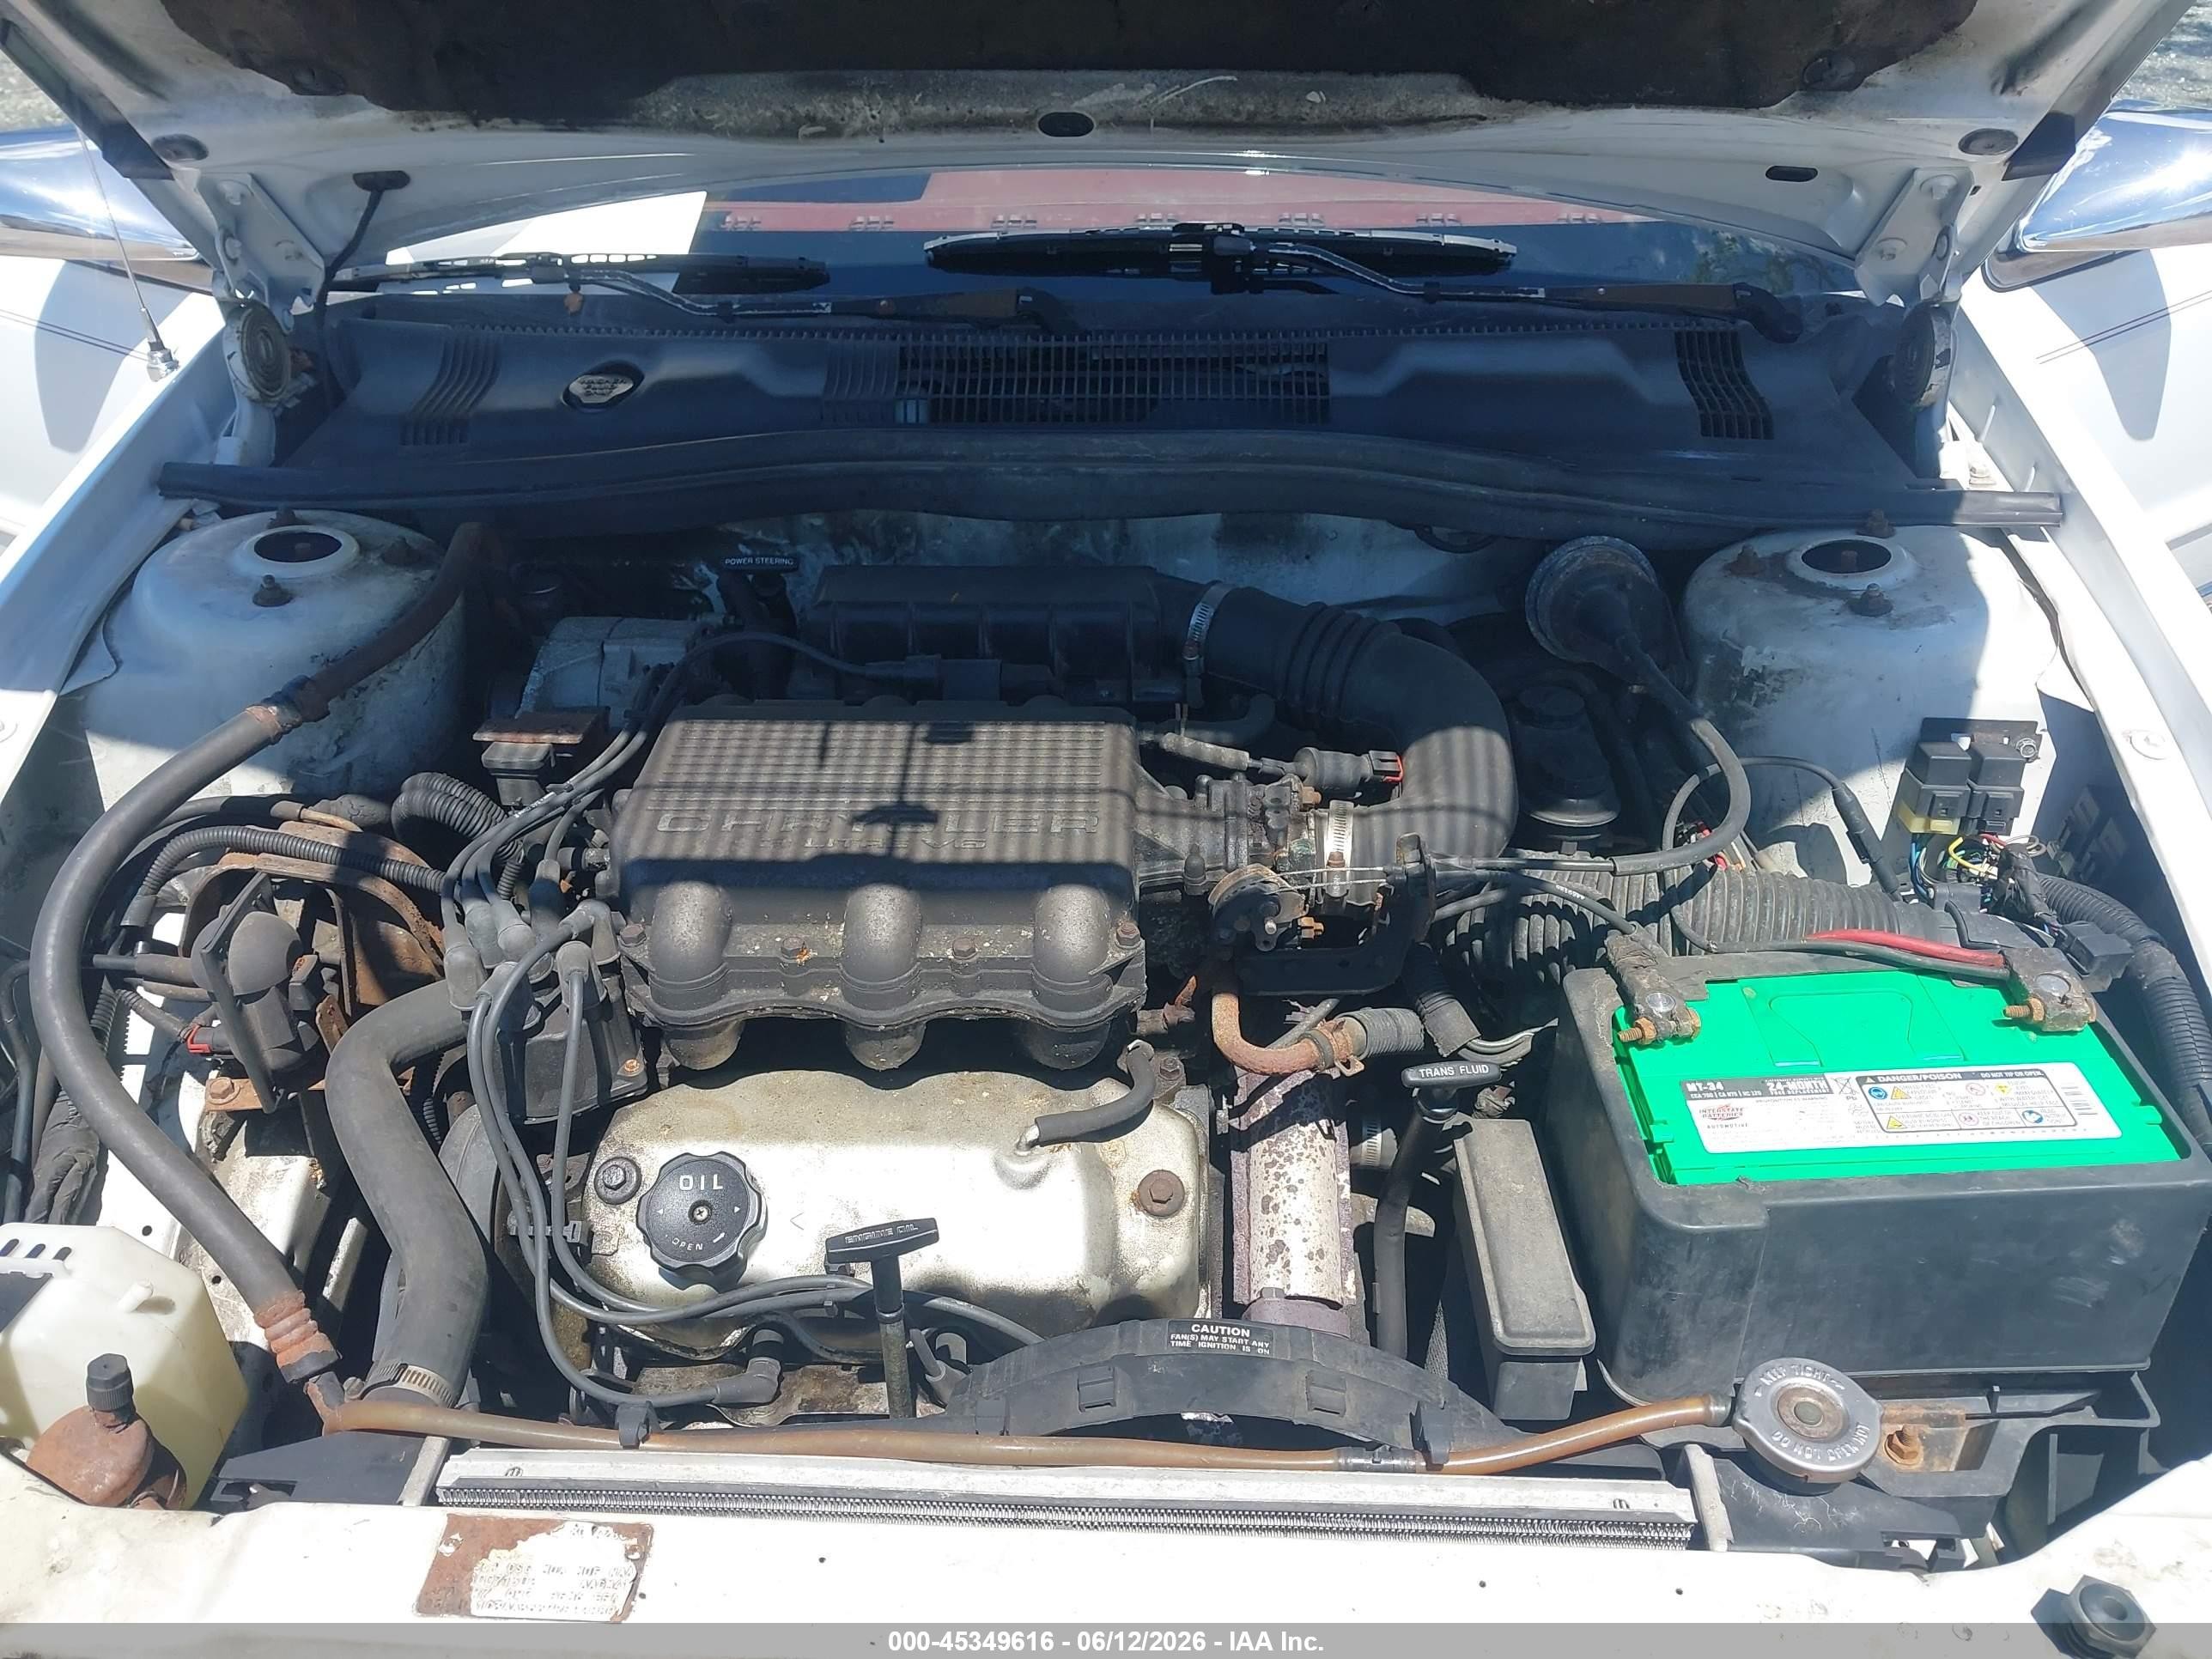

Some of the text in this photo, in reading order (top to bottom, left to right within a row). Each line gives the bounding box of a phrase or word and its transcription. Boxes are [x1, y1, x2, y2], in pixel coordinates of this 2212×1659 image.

[725, 556, 794, 566] POWER STEERING
[656, 813, 1099, 834] CHRYSLER
[1419, 1064, 1489, 1079] TRANS FLUID
[1877, 1073, 1963, 1083] DANGER/POISON
[1686, 1081, 1724, 1091] MT-34
[1766, 1079, 1829, 1091] 24-MONTH
[679, 1173, 724, 1191] OIL
[844, 1224, 919, 1243] ENGINE OIL
[672, 1237, 704, 1251] OPEN
[1191, 1323, 1250, 1338] CAUTION
[1170, 1334, 1198, 1342] FAN(S)
[1221, 1336, 1249, 1346] START
[1251, 1340, 1270, 1348] ANY
[1198, 1341, 1237, 1351] IGNITION
[1790, 1364, 1831, 1382] TIGHT
[1771, 1431, 1791, 1449] DO
[1793, 1443, 1821, 1460] NOT
[1826, 1442, 1859, 1462] OPEN
